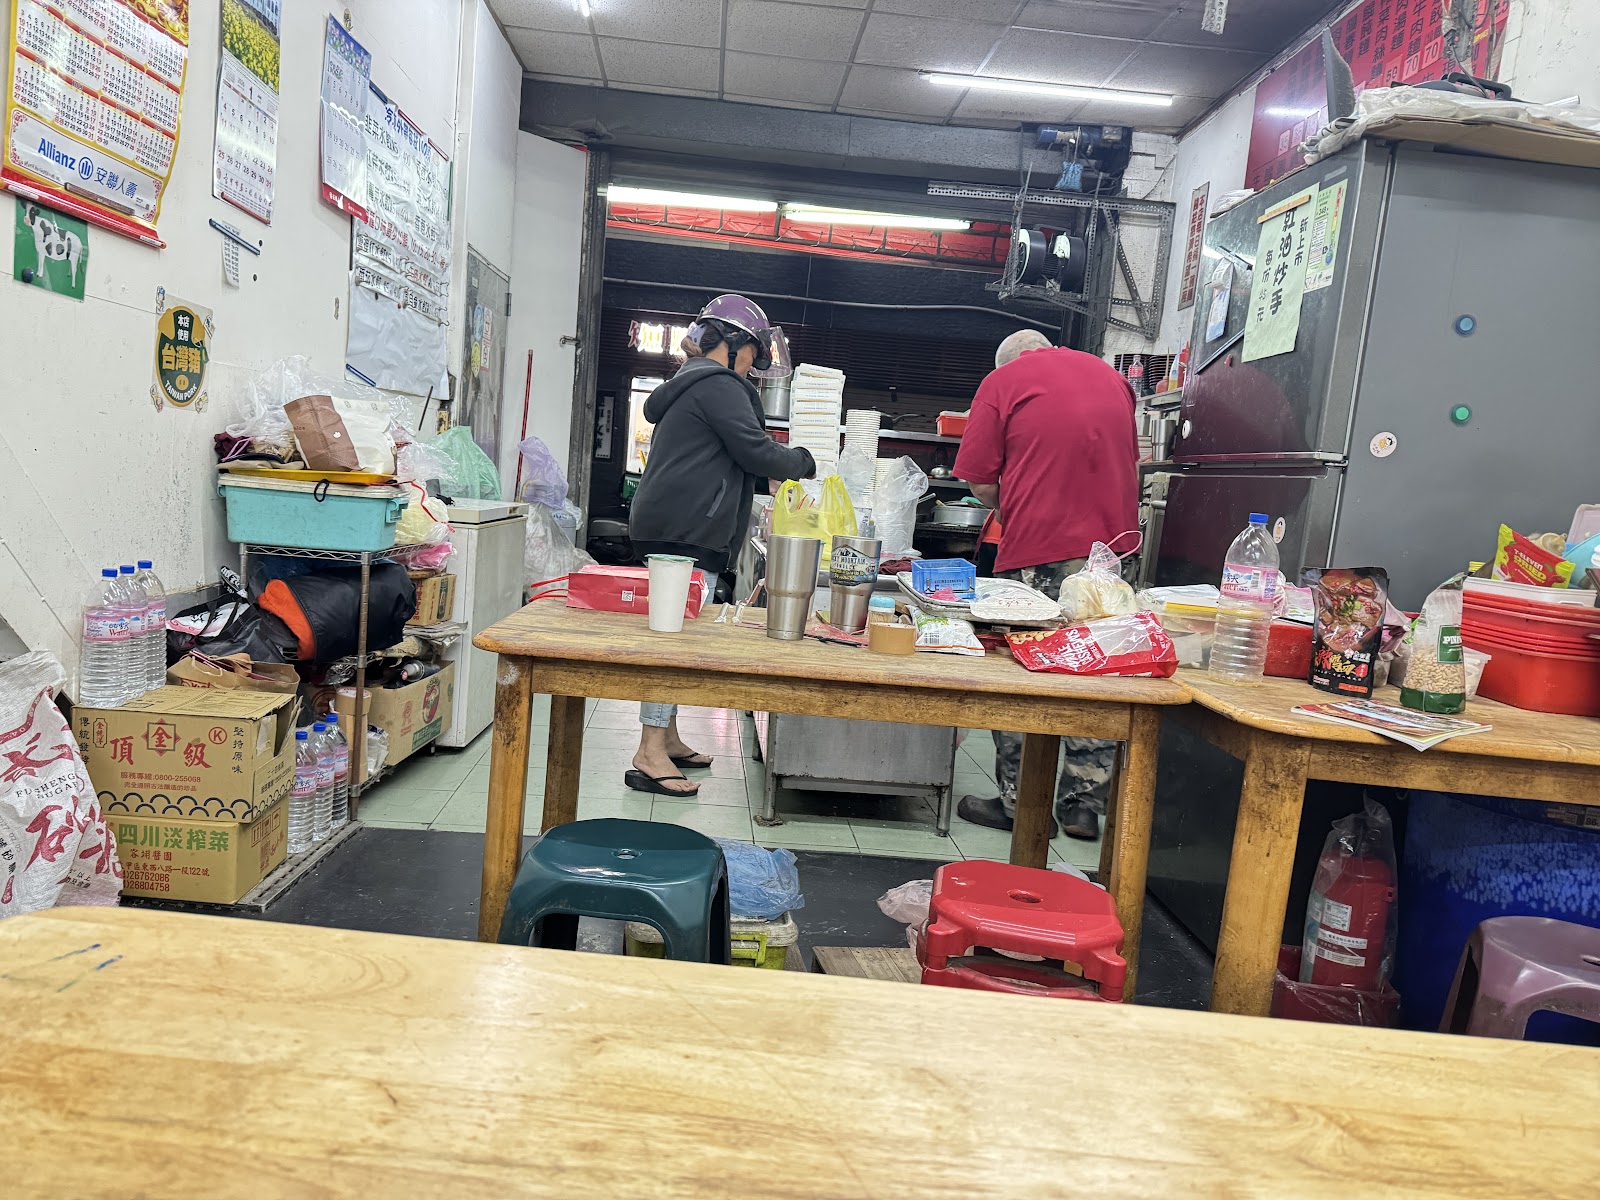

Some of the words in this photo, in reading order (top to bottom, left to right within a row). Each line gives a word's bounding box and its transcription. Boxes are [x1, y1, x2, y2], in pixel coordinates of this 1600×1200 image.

[1371, 0, 1390, 79] 菜肉絲麵
[1424, 42, 1439, 63] 70
[1405, 55, 1419, 76] 70
[38, 138, 77, 170] Allianz
[94, 167, 138, 199] 安聯人壽
[178, 315, 190, 328] 本店
[177, 328, 189, 341] 使用
[162, 343, 200, 374] 台灣豬
[164, 380, 183, 400] TAIWAN
[184, 383, 198, 400] PORK
[1514, 548, 1543, 571] 7-ELEVEN
[1514, 554, 1547, 583] DRIED
[150, 726, 173, 749] 金
[231, 726, 244, 774] 堅持原味
[118, 823, 229, 852] 四川淡榨菜
[121, 862, 210, 877] 甲區東西八路一段122號
